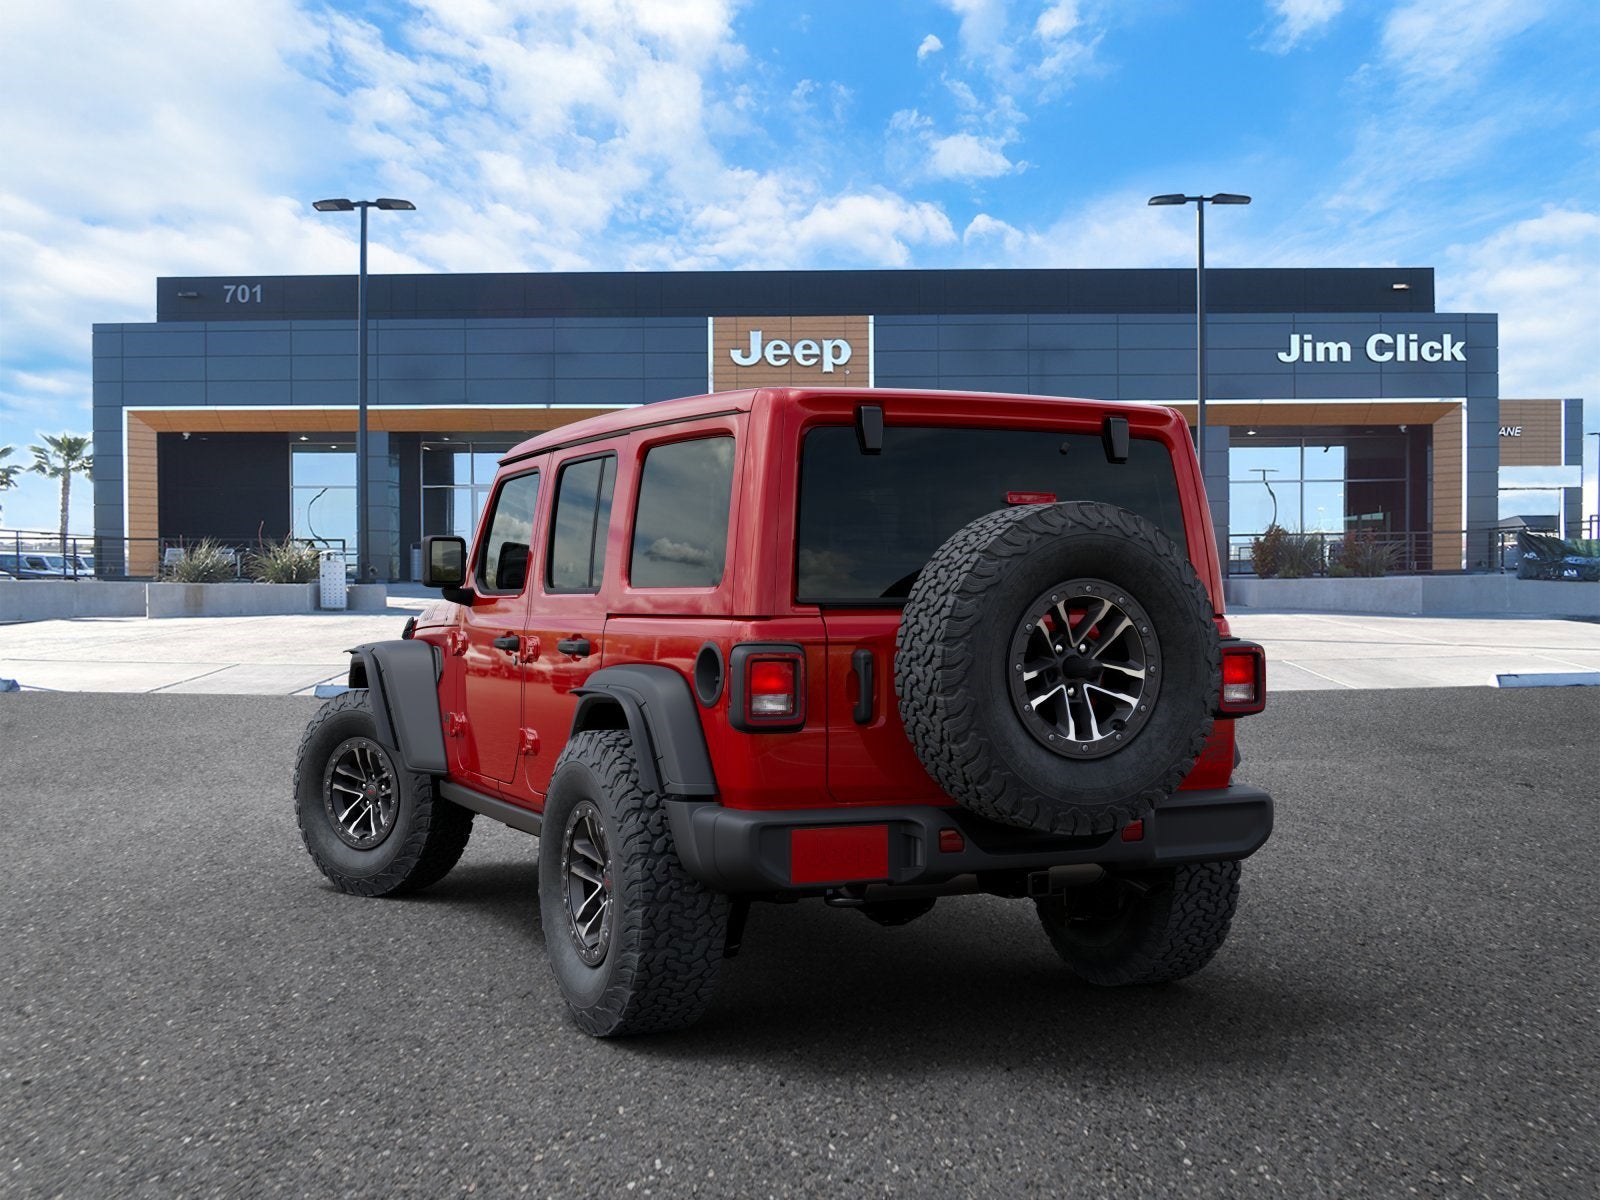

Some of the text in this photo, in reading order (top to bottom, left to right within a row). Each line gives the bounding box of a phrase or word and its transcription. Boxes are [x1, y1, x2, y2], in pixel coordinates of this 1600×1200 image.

[223, 284, 262, 303] 701
[730, 330, 852, 373] Jeep
[1277, 333, 1467, 363] Jim Click
